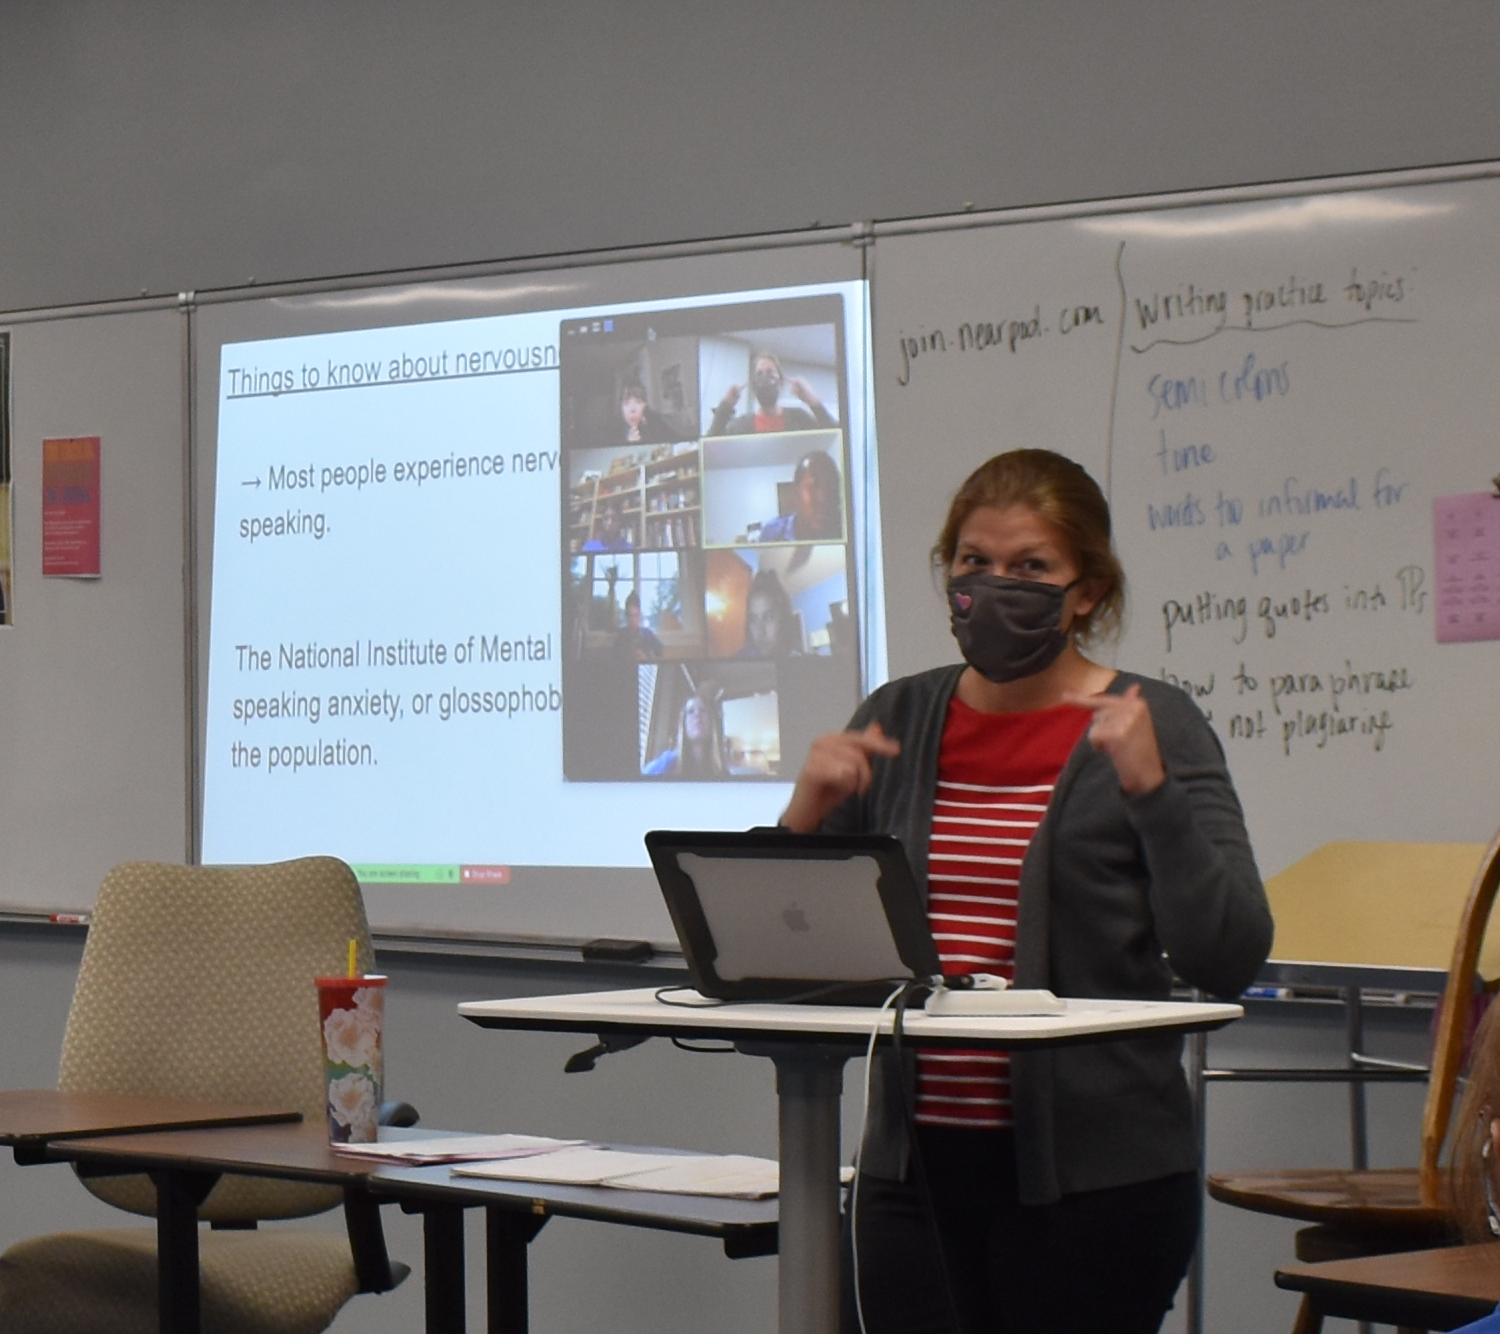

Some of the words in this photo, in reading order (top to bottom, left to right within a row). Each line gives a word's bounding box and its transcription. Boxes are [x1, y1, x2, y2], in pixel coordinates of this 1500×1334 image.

[1135, 283, 1228, 329] Writing
[1243, 275, 1327, 329] practice
[228, 366, 295, 396] Things
[301, 364, 320, 389] to
[327, 360, 381, 386] know
[388, 350, 449, 380] about
[455, 344, 560, 375] nervousn
[268, 463, 315, 490] Most
[321, 458, 387, 493] people
[393, 452, 504, 486] experience
[511, 449, 560, 472] nerv
[1373, 466, 1411, 509] for
[239, 508, 331, 543] speaking.
[1216, 541, 1234, 561] a
[1248, 531, 1312, 576] paper
[1162, 589, 1248, 652] putting
[1258, 587, 1330, 639] quotes
[235, 644, 272, 671] The
[278, 640, 360, 670] National
[368, 639, 448, 667] Institute
[454, 636, 476, 664] of
[480, 633, 553, 663] Mental
[1233, 662, 1259, 695] to
[233, 690, 320, 726] speaking
[328, 688, 405, 723] anxiety,
[411, 692, 434, 715] or
[439, 683, 563, 721] glossophob
[1229, 709, 1267, 740] not
[231, 741, 261, 768] the
[268, 738, 379, 773] population.
